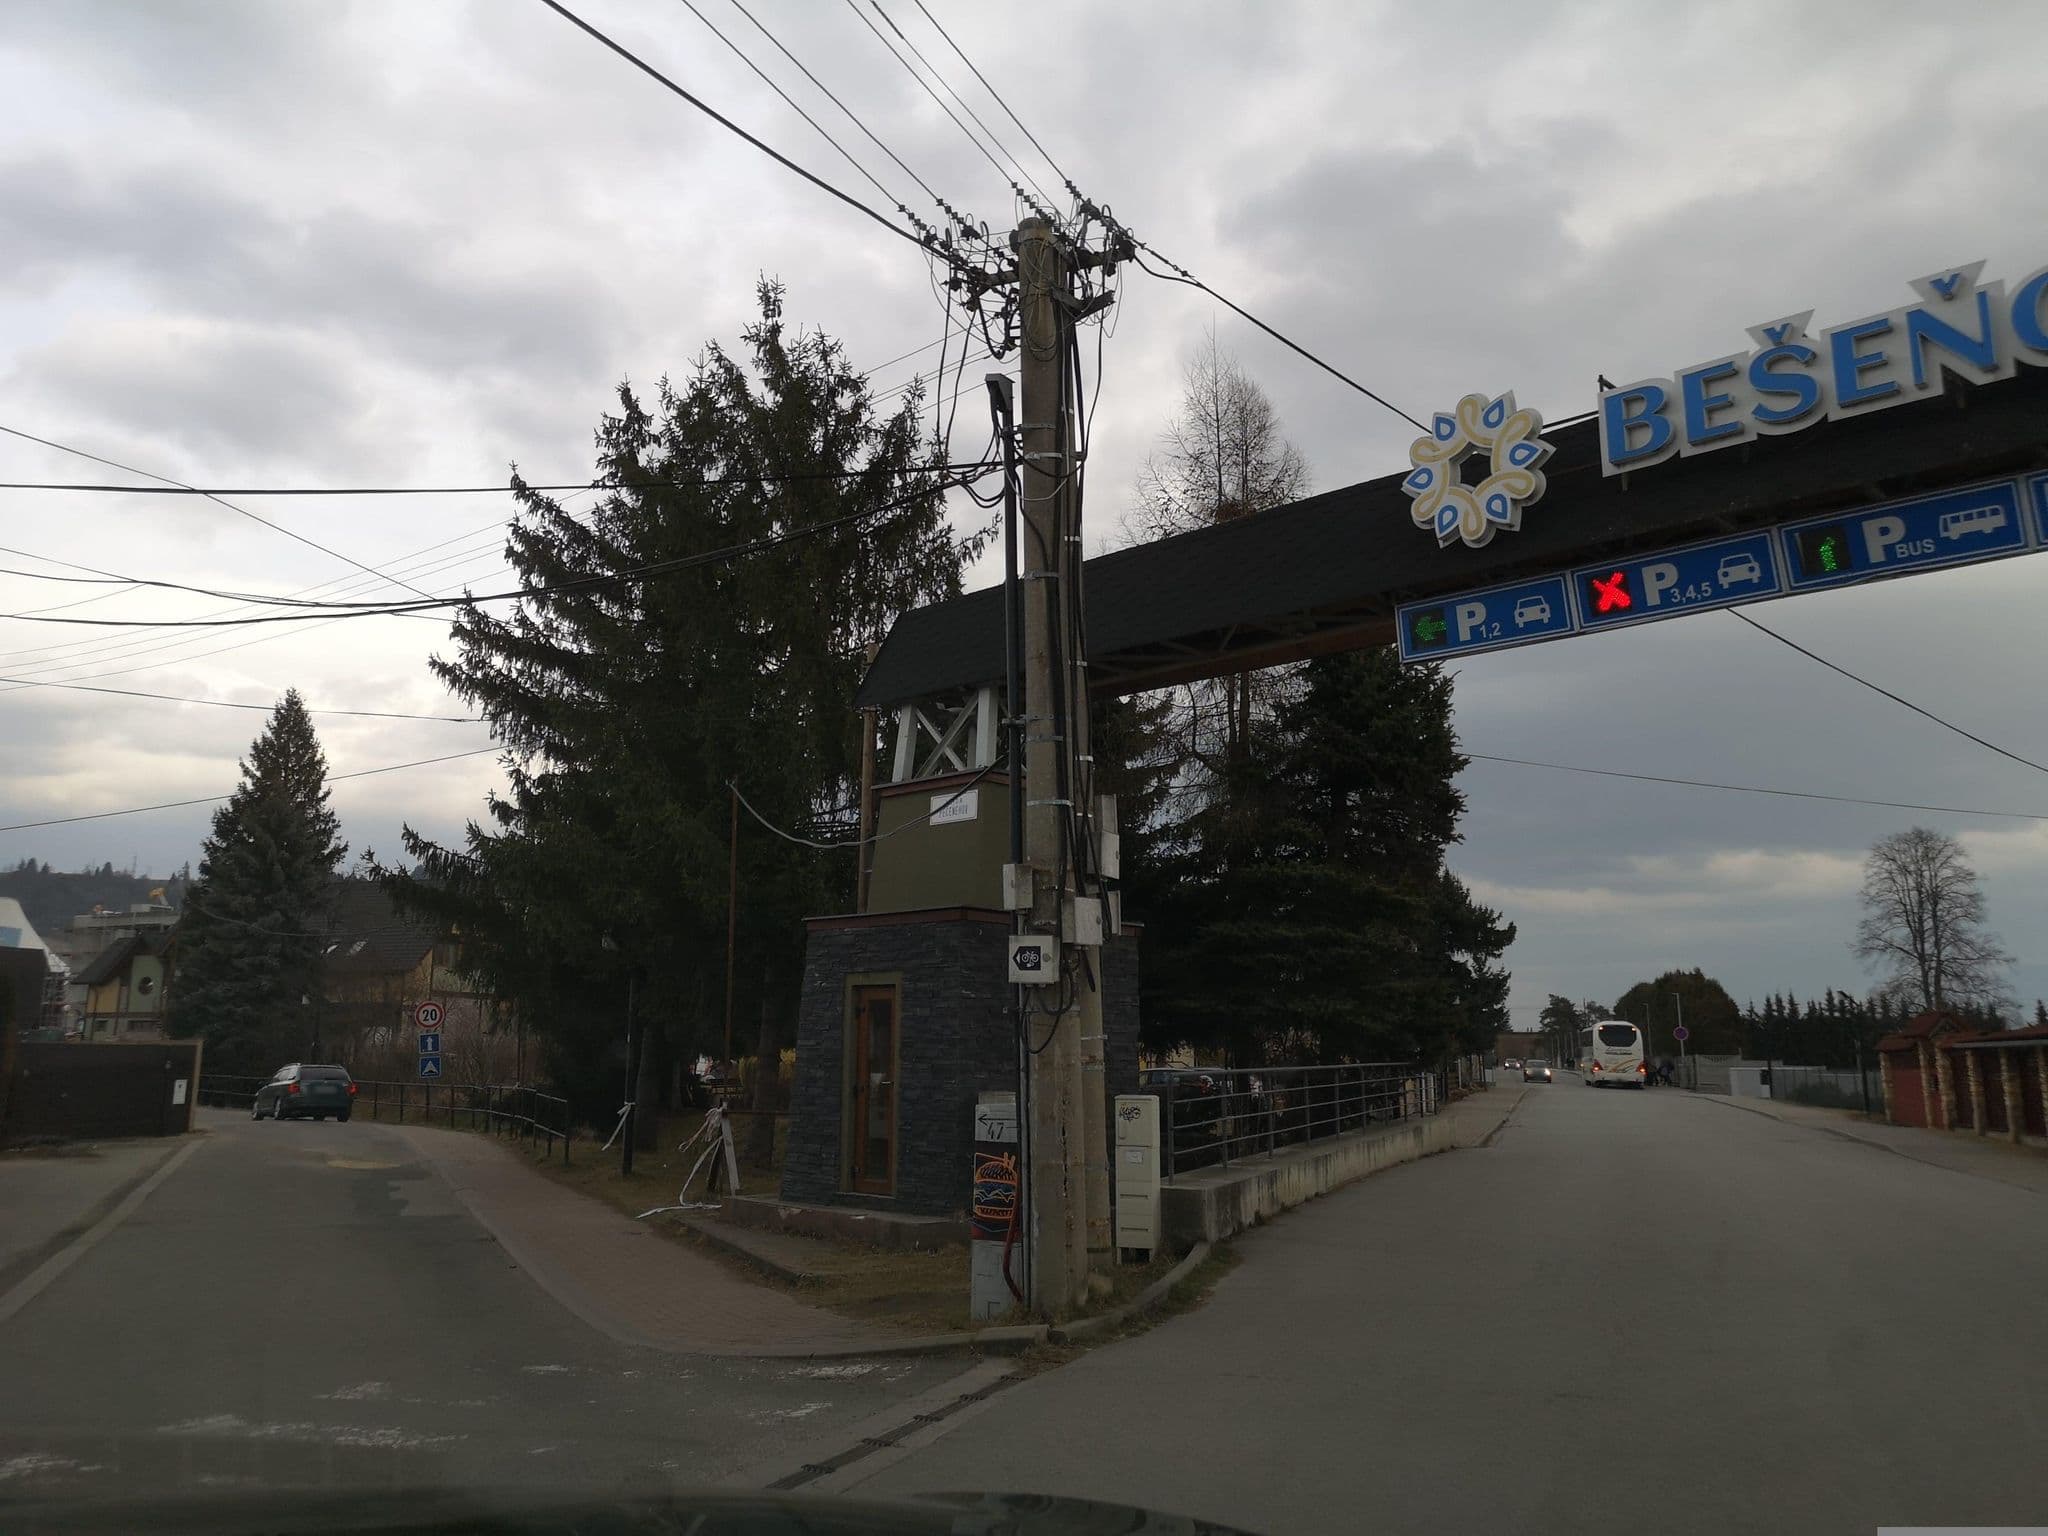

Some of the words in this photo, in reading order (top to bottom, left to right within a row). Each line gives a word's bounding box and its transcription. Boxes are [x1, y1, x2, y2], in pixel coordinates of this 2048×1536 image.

[1861, 516, 1906, 564] P
[1895, 537, 1937, 559] BUS
[1641, 562, 1679, 607] P
[1670, 581, 1712, 604] 3,4,5
[1455, 601, 1487, 642] P
[1480, 621, 1501, 640] 1,2
[422, 1009, 438, 1022] 20
[987, 1121, 1005, 1140] 47
